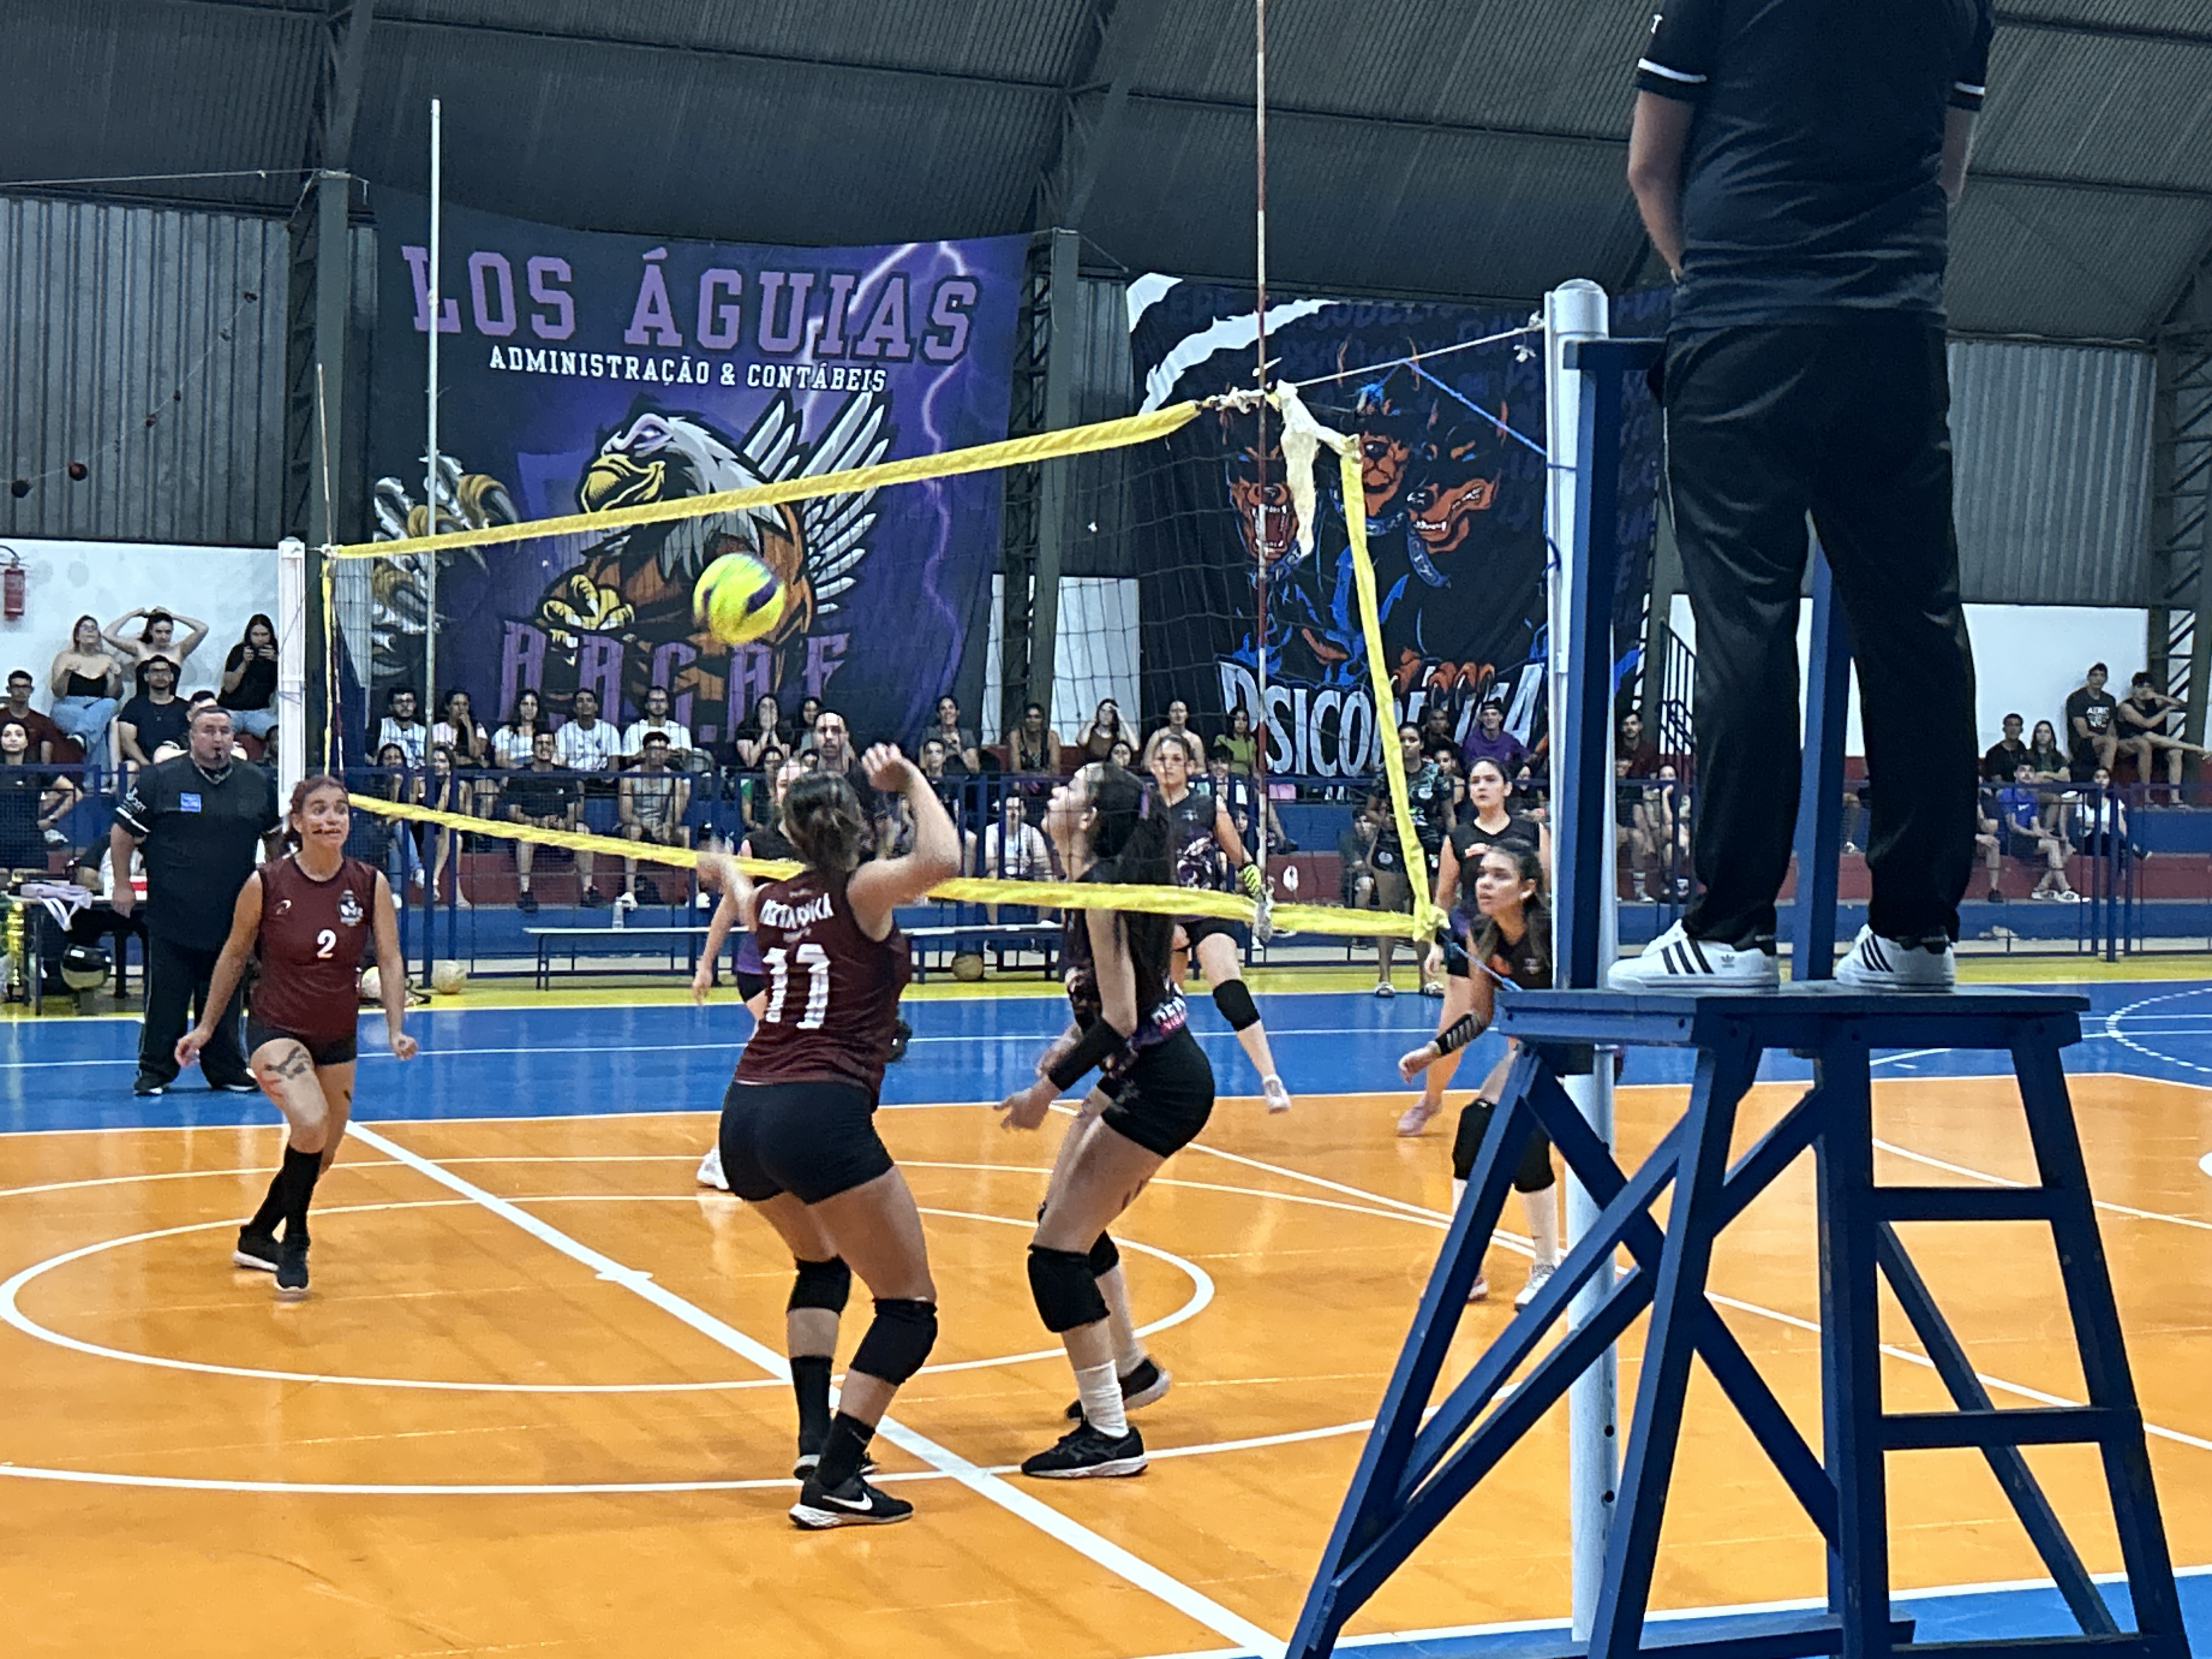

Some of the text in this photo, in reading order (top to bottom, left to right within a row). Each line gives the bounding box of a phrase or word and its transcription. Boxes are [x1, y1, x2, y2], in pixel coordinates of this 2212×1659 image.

[402, 245, 977, 361] LOS ÁGUIAS
[489, 345, 887, 392] ADMINISTRAÇÃO & CONTÁBEIS
[317, 928, 337, 959] 2
